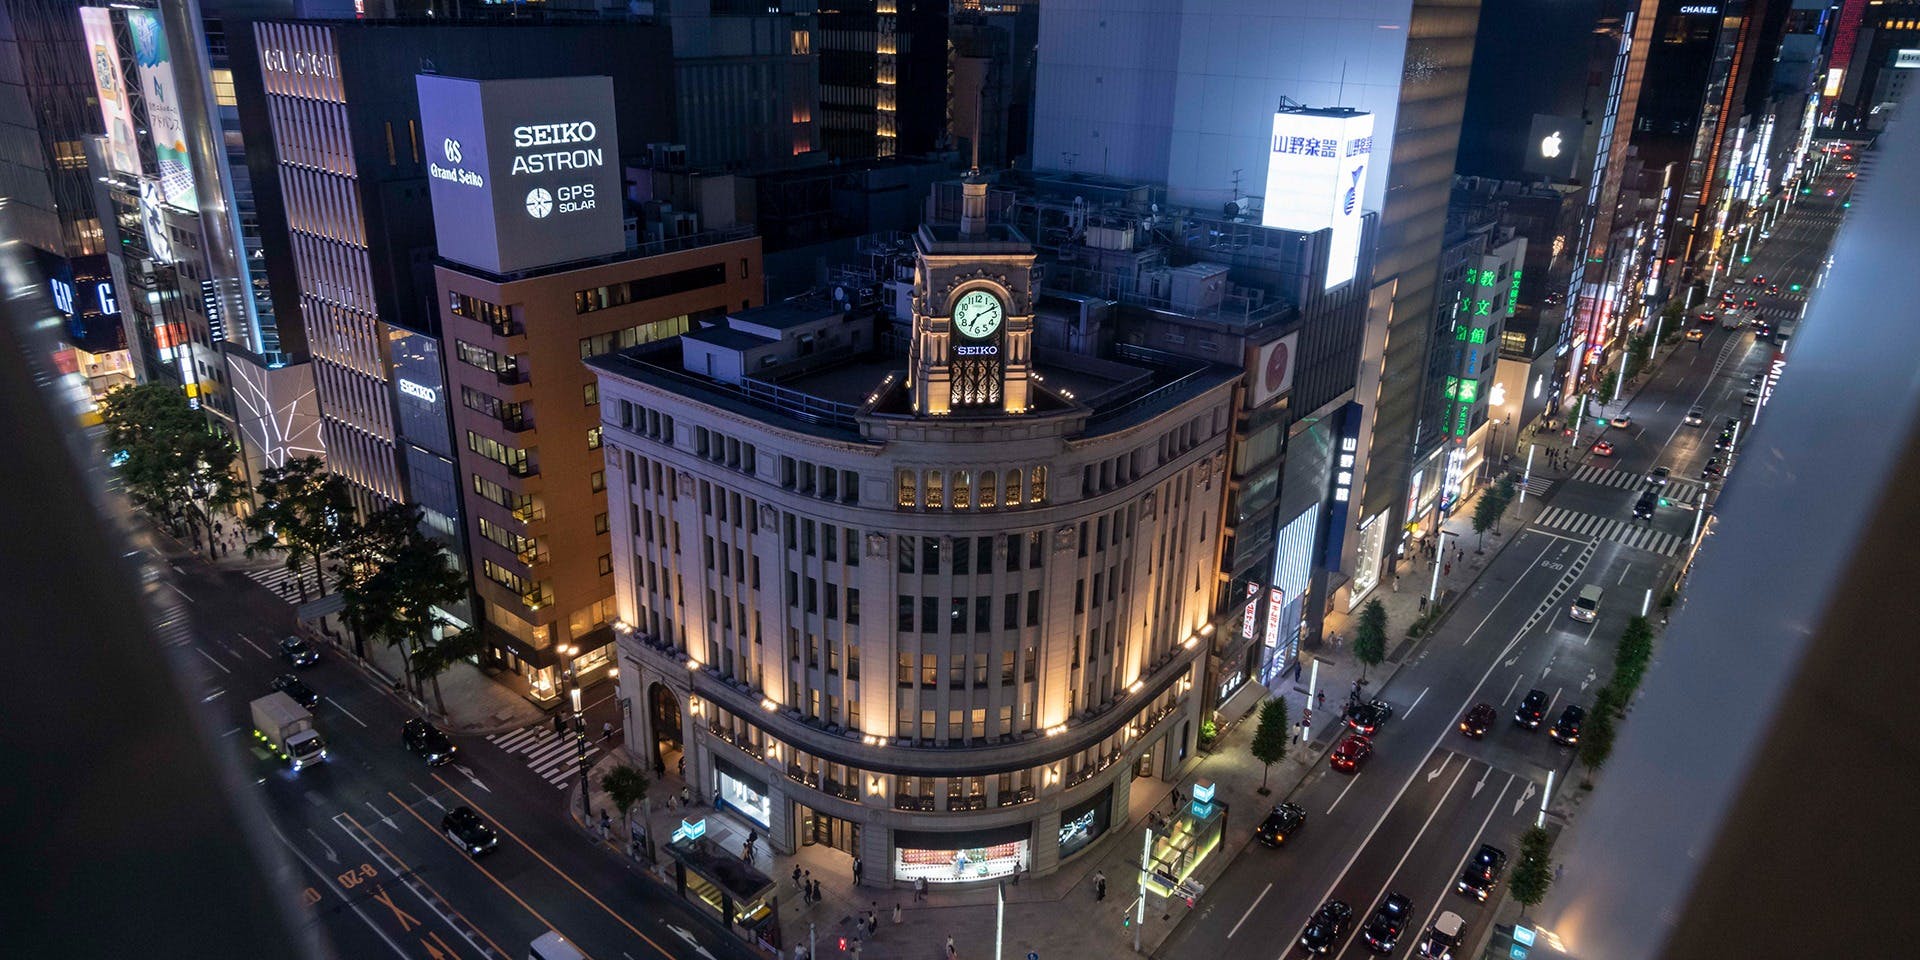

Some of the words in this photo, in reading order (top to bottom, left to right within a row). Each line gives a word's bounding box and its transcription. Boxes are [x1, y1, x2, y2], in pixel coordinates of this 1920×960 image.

[1680, 6, 1718, 14] CHANEL
[513, 120, 596, 148] SEIKO
[1273, 134, 1337, 158] 山野楽器
[511, 148, 603, 176] ASTRON
[430, 162, 458, 182] Grand
[458, 168, 484, 188] Seiko
[557, 183, 595, 201] GPS
[559, 200, 596, 213] SOLAR
[51, 277, 75, 315] GAP
[968, 296, 974, 304] 11
[976, 295, 982, 303] 12
[959, 311, 965, 319] 9
[1469, 269, 1496, 345] 教文館
[958, 346, 998, 355] SEIKO
[399, 378, 437, 403] SEIKO
[1541, 559, 1564, 571] 8-20
[337, 863, 378, 889] 8-20
